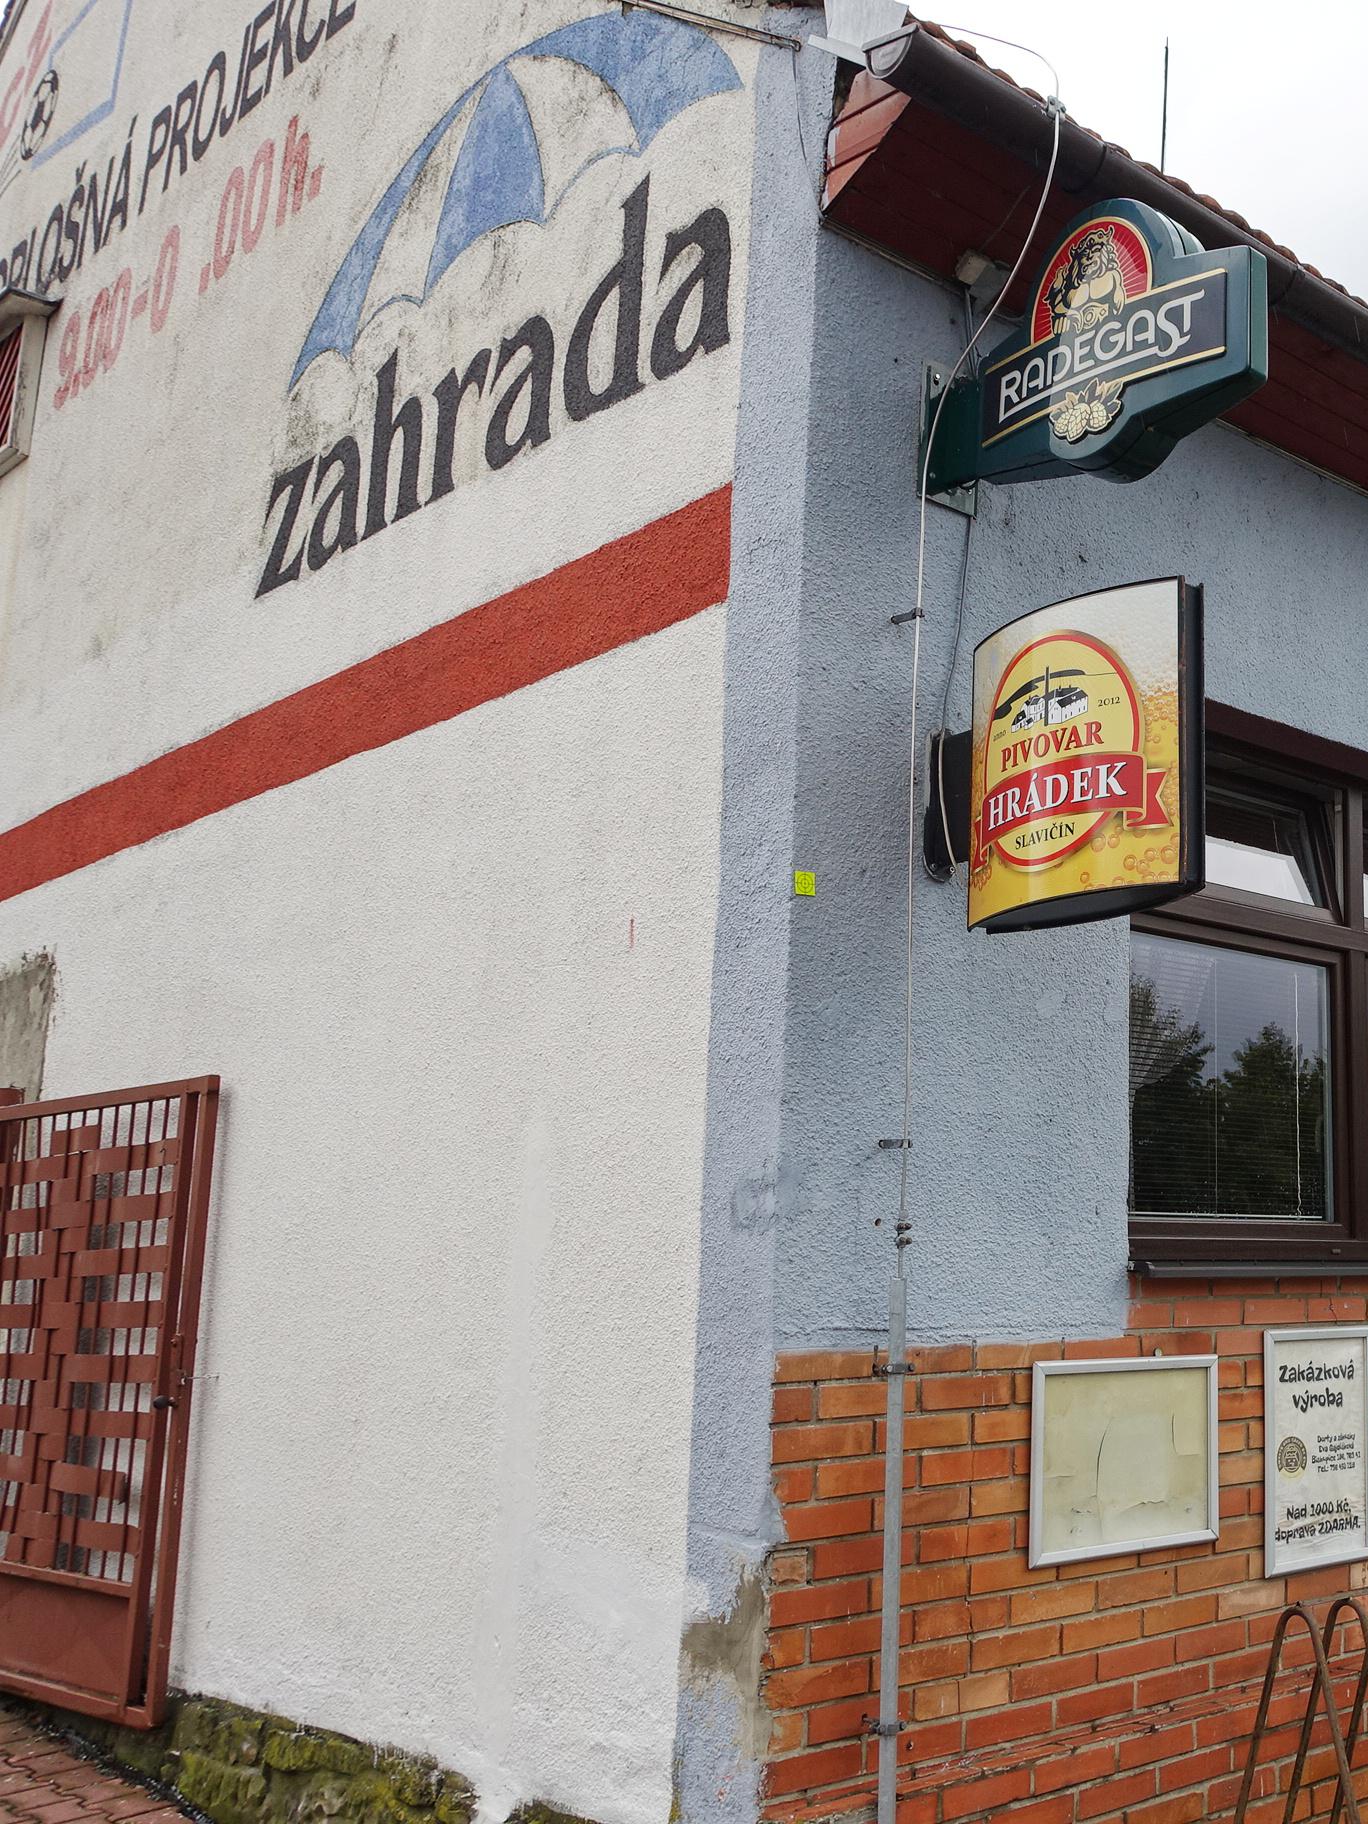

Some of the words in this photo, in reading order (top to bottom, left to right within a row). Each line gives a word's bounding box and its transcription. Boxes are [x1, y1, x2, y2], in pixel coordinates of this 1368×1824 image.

[999, 289, 1205, 425] RADEGAST
[254, 172, 731, 600] zahrada
[1097, 696, 1121, 708] 2012
[1000, 720, 1104, 773] PIVOVAR
[987, 760, 1128, 832] HRÁDEK
[1014, 821, 1076, 850] SLAVIČÍN
[1279, 1359, 1355, 1383] Zakázková
[1292, 1387, 1343, 1413] výroba
[1286, 1504, 1307, 1520] Nad
[1310, 1501, 1334, 1517] 1000
[1274, 1526, 1316, 1544] doprava
